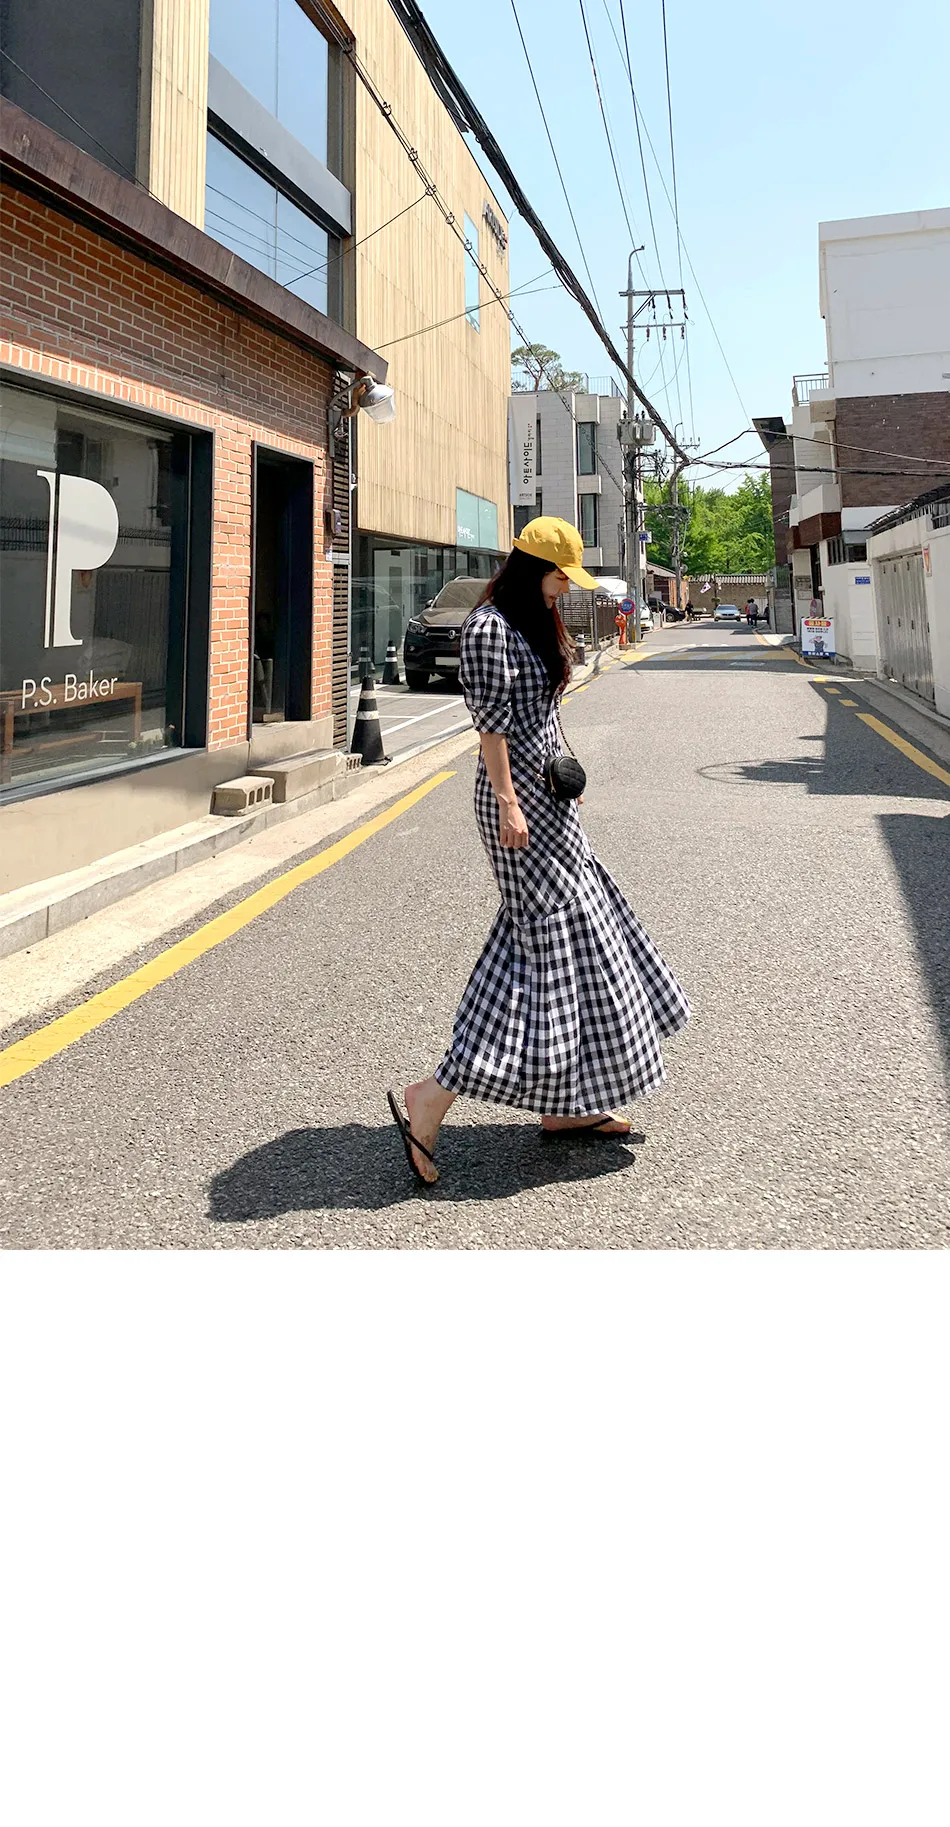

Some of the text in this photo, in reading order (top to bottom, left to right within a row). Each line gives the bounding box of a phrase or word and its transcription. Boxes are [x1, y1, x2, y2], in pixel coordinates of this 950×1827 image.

[523, 443, 533, 484] 아트사이드
[37, 470, 119, 649] P
[22, 670, 118, 709] P.S. Baker
